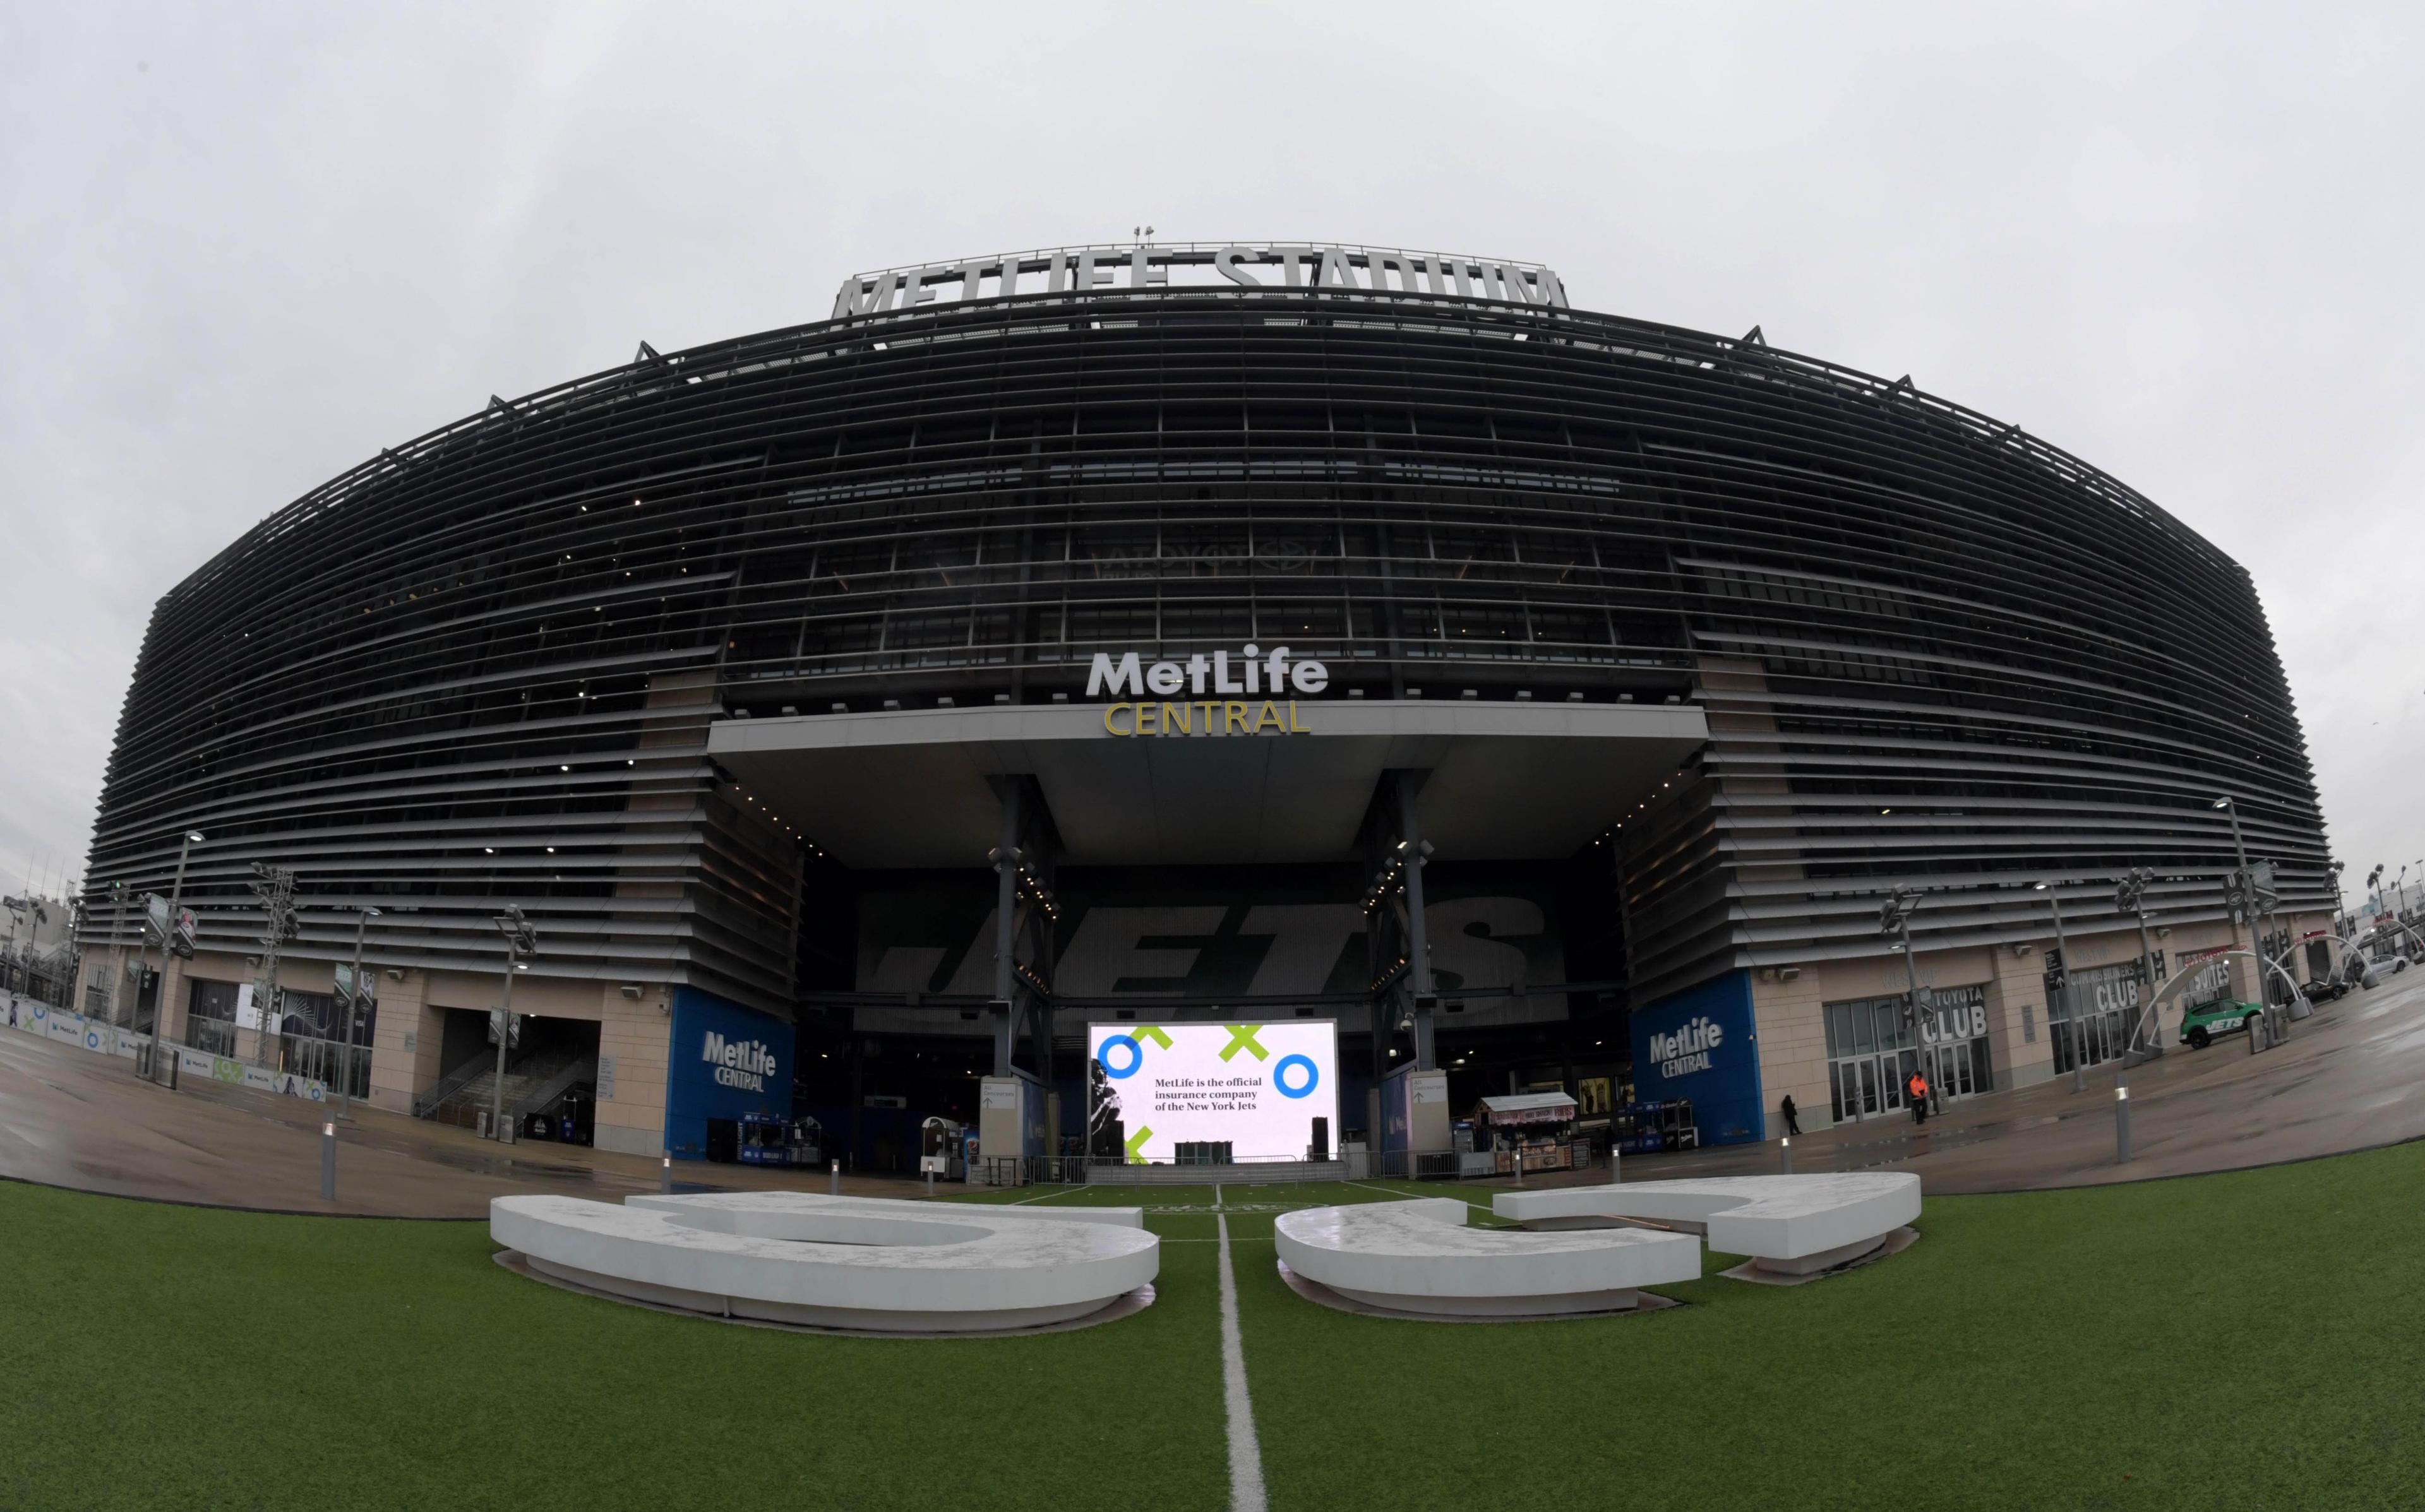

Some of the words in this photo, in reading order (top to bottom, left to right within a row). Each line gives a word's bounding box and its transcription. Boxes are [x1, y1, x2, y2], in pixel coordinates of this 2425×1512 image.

[1214, 247, 1571, 321] STADIUM
[1086, 643, 1329, 697] MetLife
[1104, 700, 1311, 736] CENTRAL
[1934, 985, 1983, 1007] TOYOTA
[2096, 980, 2138, 1012] CLUB
[59, 1024, 78, 1036] MetLife
[2205, 1016, 2244, 1031] JETS
[1649, 1016, 1723, 1064] MetLife
[192, 1060, 208, 1069] MetLife
[702, 1030, 776, 1078] MetLife
[1661, 1051, 1713, 1079] CENTRAL
[254, 1074, 269, 1083] MetLife
[714, 1065, 764, 1093] CENTRAL
[1155, 1079, 1194, 1087] MetLife
[1207, 1078, 1224, 1086] the
[1226, 1078, 1262, 1086] official
[1155, 1091, 1207, 1099] insurance
[1209, 1092, 1257, 1100] company
[1155, 1102, 1166, 1111] of
[1168, 1102, 1184, 1111] the
[1187, 1102, 1209, 1110] New
[1211, 1102, 1235, 1110] York
[1238, 1102, 1257, 1110] Jets
